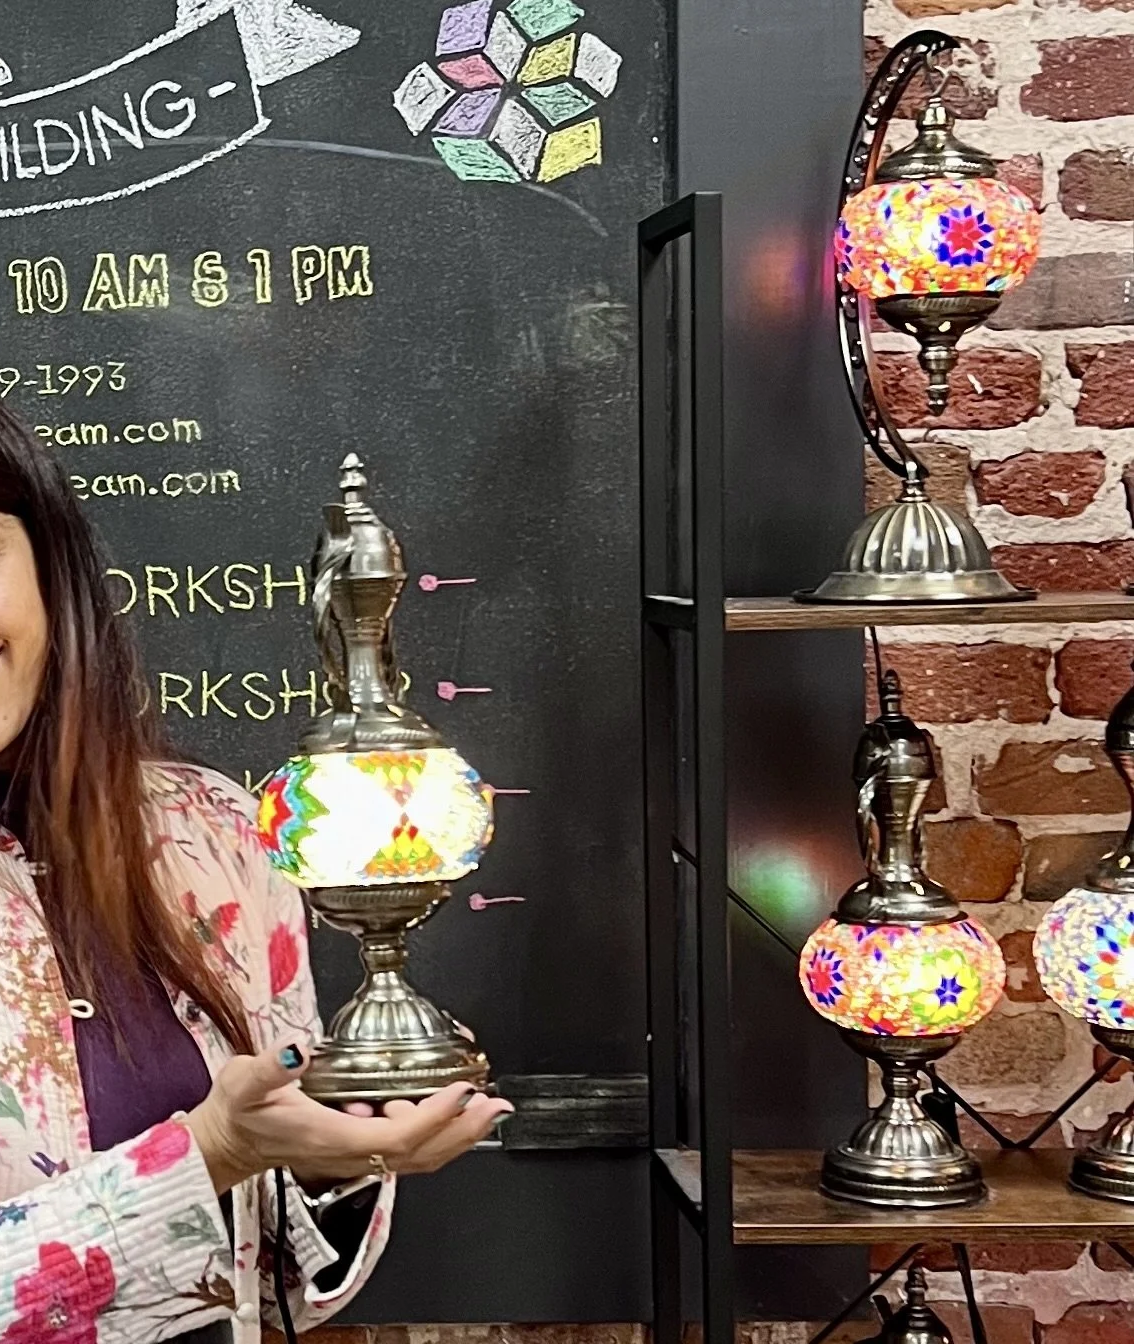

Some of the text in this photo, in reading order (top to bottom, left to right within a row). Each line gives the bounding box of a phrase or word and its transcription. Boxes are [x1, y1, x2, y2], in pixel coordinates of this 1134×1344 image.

[8, 256, 69, 315] 10
[82, 252, 170, 312] AM
[246, 248, 272, 304] 1
[291, 244, 374, 306] PM
[106, 563, 306, 618] ORKSH
